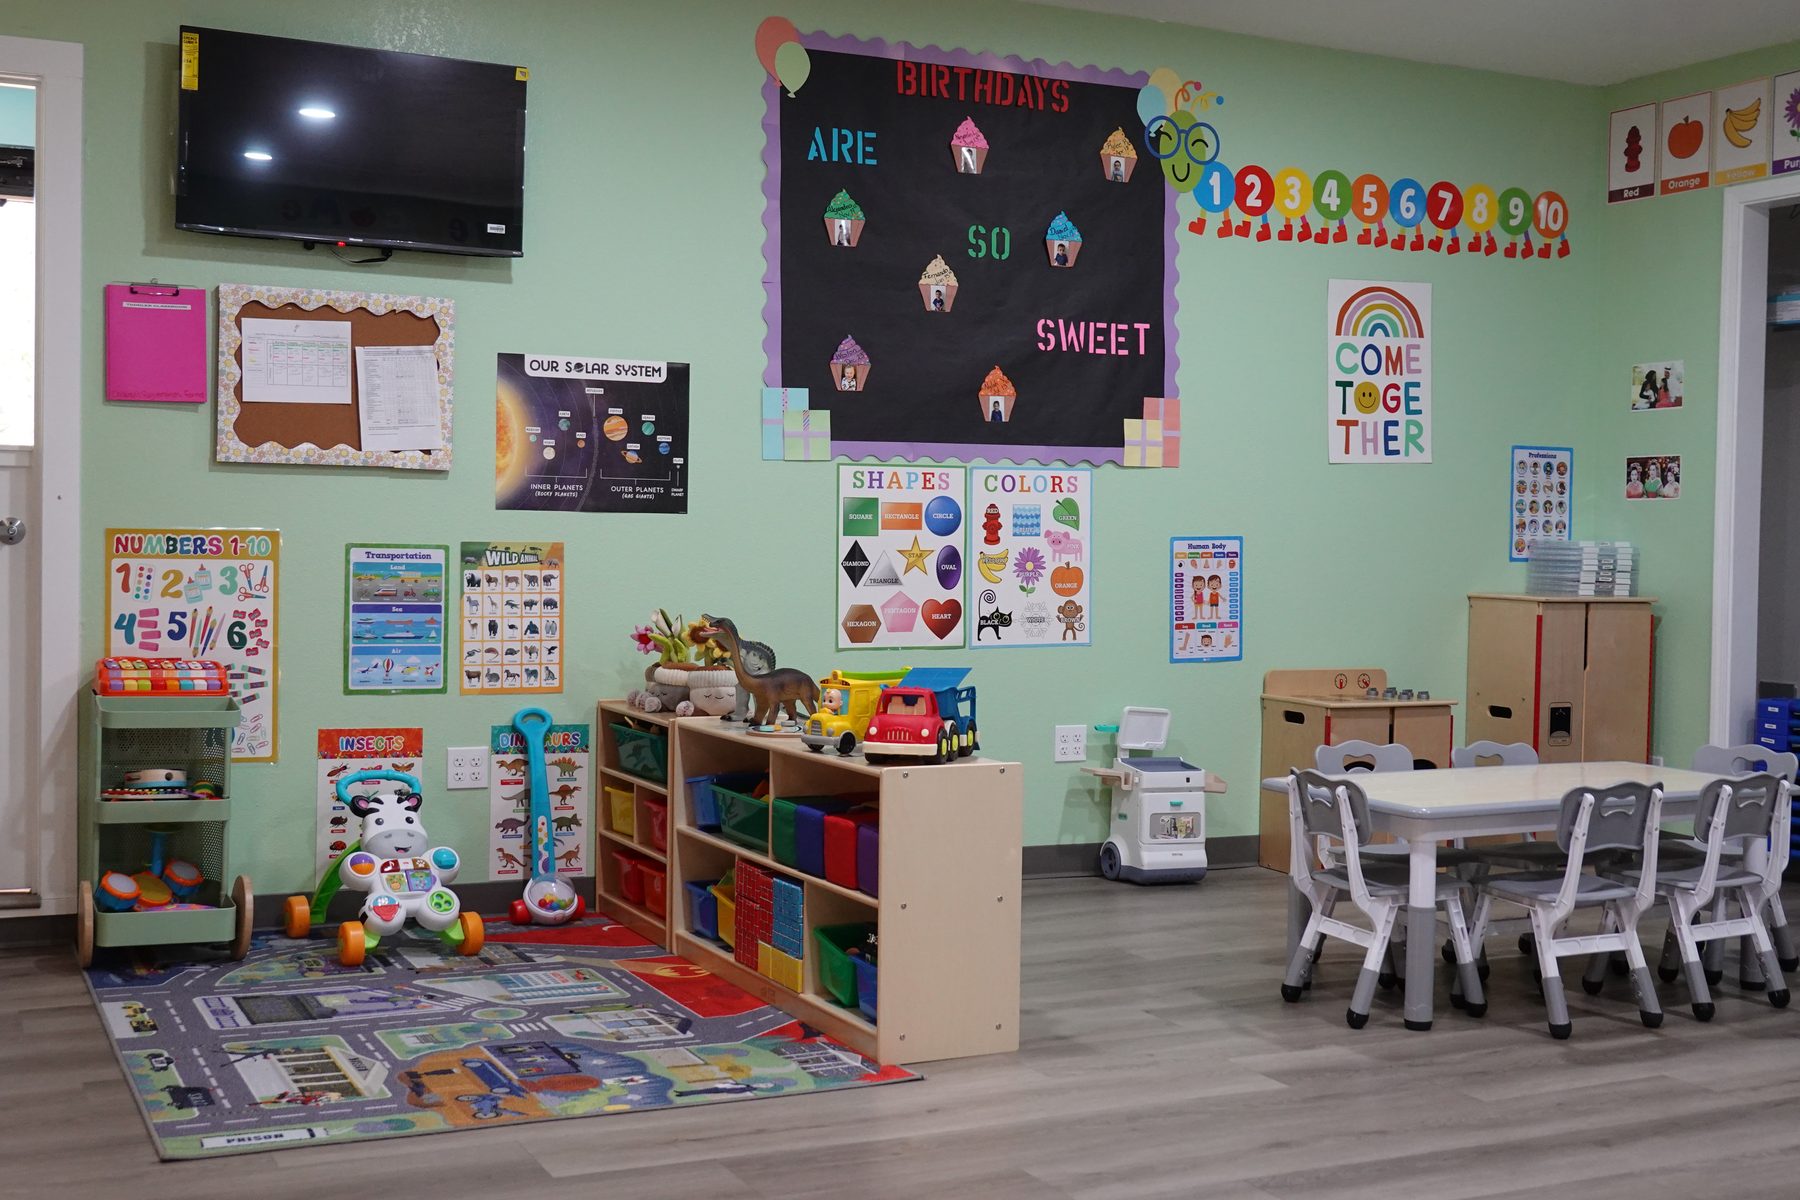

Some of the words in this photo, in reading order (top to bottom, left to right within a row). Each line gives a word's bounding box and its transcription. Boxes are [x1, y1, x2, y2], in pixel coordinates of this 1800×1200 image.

[896, 60, 1070, 112] BIRTHDAYS
[807, 126, 878, 166] ARE
[1623, 187, 1640, 198] Red
[1668, 176, 1700, 189] Orange
[1208, 171, 1220, 205] 1
[1244, 174, 1262, 206] 2
[1285, 176, 1301, 210] 3
[1323, 179, 1340, 211] 4
[1363, 184, 1377, 215] 5
[1401, 188, 1416, 219] 6
[1437, 192, 1453, 221] 7
[1472, 193, 1488, 223] 8
[1509, 197, 1524, 226] 9
[1538, 199, 1563, 231] 10
[967, 224, 1011, 260] SO
[1037, 318, 1150, 355] SWEET
[530, 360, 559, 372] OUR
[616, 364, 662, 377] SYSTEM
[1335, 342, 1422, 376] COME
[1336, 419, 1425, 457] THER
[853, 470, 950, 490] SHAPES
[984, 474, 1078, 493] COLORS
[114, 535, 224, 556] NUMBERS
[230, 536, 272, 556] 1-10
[365, 551, 432, 561] Transportation
[486, 550, 518, 566] WILD
[115, 563, 131, 593] 1
[161, 569, 184, 598] 2
[219, 566, 238, 595] 3
[114, 613, 137, 645] 4
[167, 611, 187, 641] 5
[227, 620, 247, 650] 6
[847, 620, 877, 628] HEXAGON
[339, 735, 405, 751] INSECTS
[500, 732, 580, 748] DINAURS
